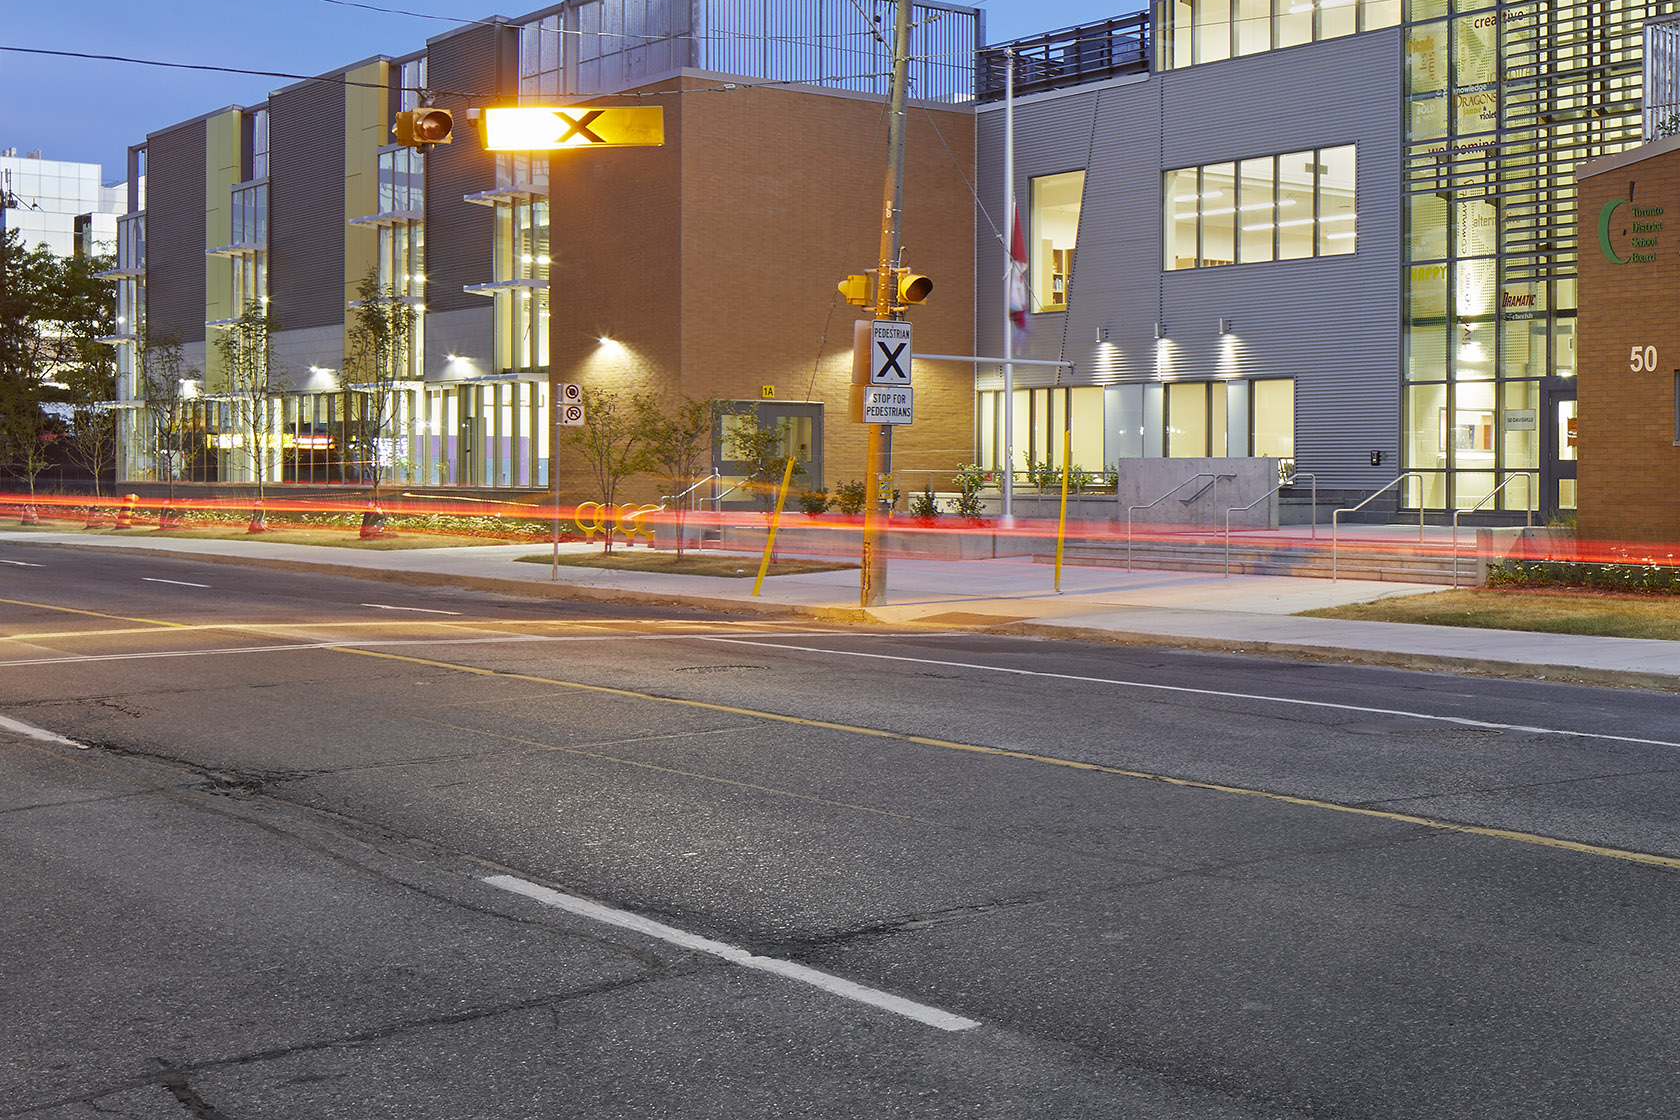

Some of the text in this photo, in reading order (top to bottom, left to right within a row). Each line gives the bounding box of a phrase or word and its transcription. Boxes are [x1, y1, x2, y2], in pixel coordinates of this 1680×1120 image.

[552, 110, 607, 143] X
[1632, 206, 1664, 217] Toronto
[1632, 221, 1664, 232] District
[1631, 236, 1657, 247] School
[1631, 252, 1657, 263] Board
[1411, 265, 1447, 280] HAPPY
[1502, 292, 1536, 307] DRAMATIC
[875, 328, 909, 339] PEDESTRIAN
[876, 341, 907, 378] X
[1630, 345, 1658, 372] 50
[764, 387, 774, 396] 1A
[873, 393, 906, 404] STOP FOR
[866, 406, 911, 417] PEDESTRIANS
